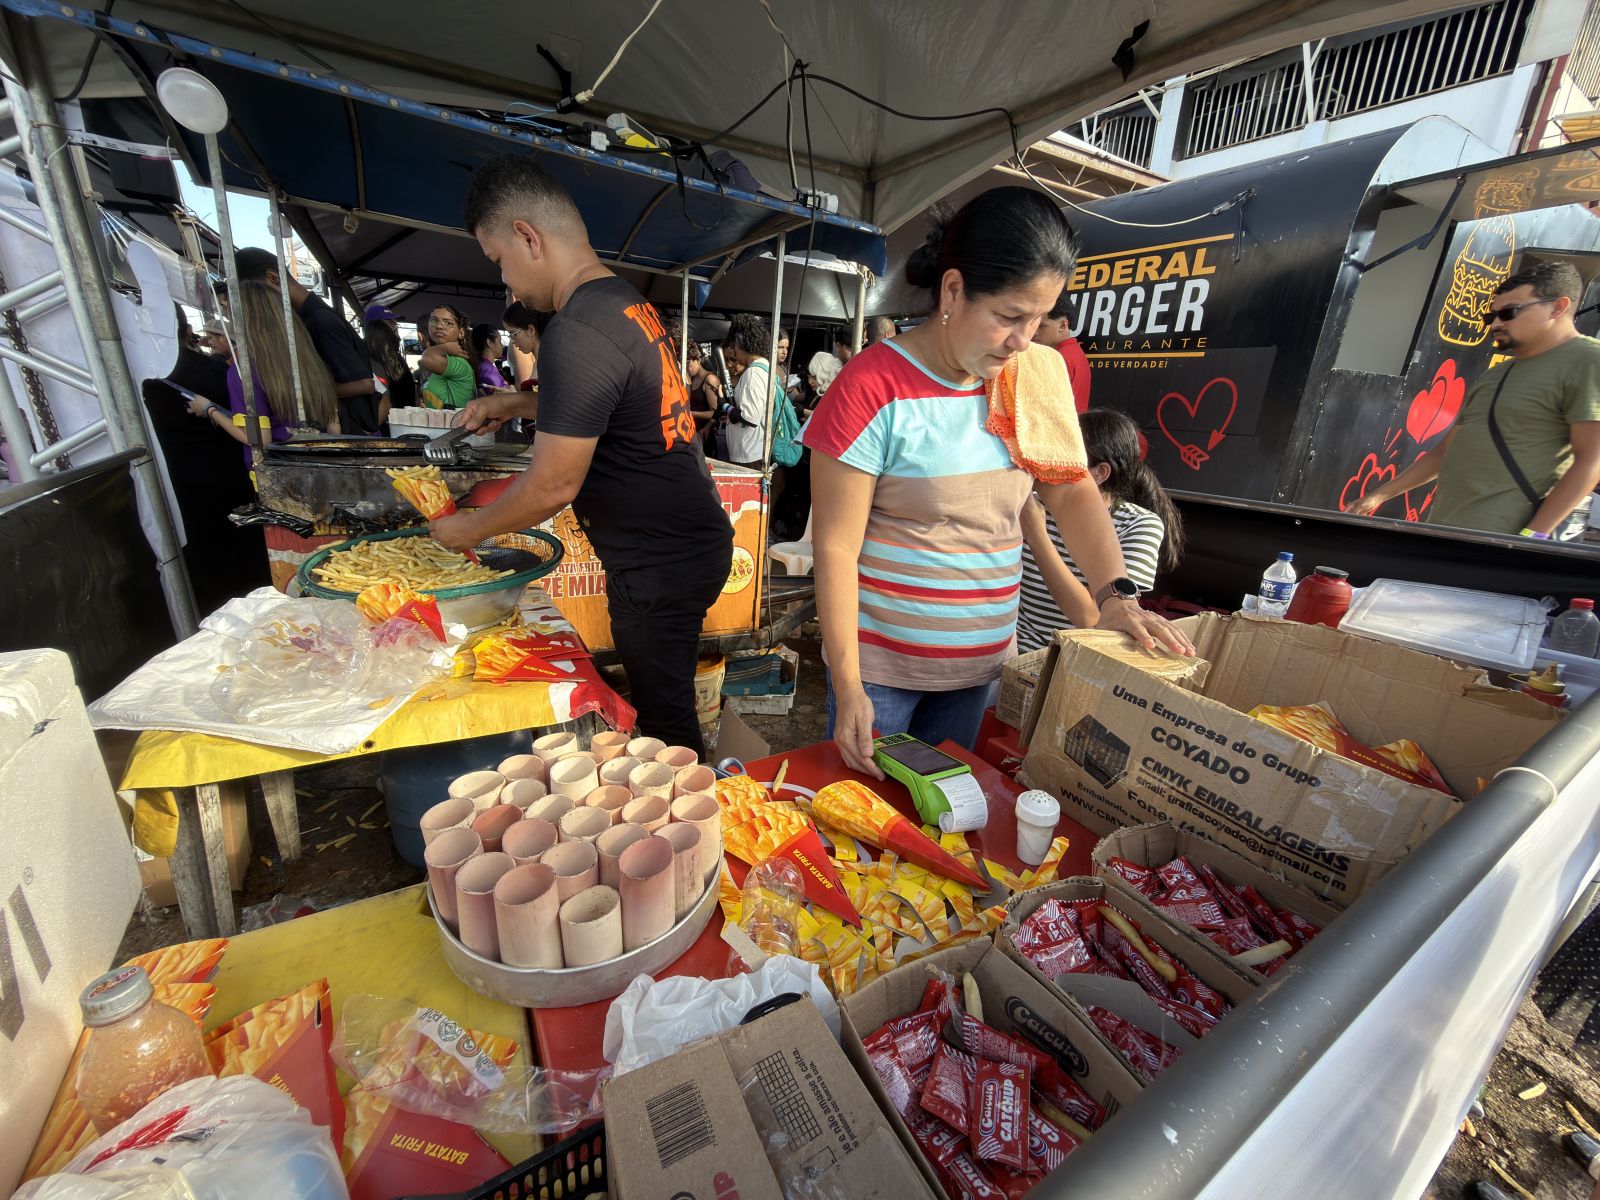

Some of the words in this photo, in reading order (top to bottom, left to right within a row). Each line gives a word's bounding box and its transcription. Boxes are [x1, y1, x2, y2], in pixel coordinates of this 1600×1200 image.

[1067, 248, 1216, 290] EDERAL
[1069, 279, 1210, 337] URGER
[1097, 361, 1110, 369] DE
[1114, 360, 1168, 369] VERDADE!
[578, 561, 604, 574] FRIT
[1112, 684, 1148, 709] Uma
[1151, 702, 1228, 747] Empresa
[1231, 738, 1257, 759] do
[1262, 754, 1322, 788] Grupo
[1150, 726, 1250, 785] COYADO
[1142, 756, 1193, 793] CMYK
[1194, 785, 1351, 872] EMBALAGENS
[792, 848, 812, 867] FRITA
[809, 866, 833, 889] BATATA
[808, 1080, 832, 1115] amasse
[1000, 1078, 1014, 1142] CATCHUP
[827, 1115, 842, 1135] não
[1028, 1110, 1060, 1143] CATC
[390, 1133, 424, 1153] FRITA
[424, 1143, 469, 1166] BATATA
[951, 1154, 991, 1198] CATCH
